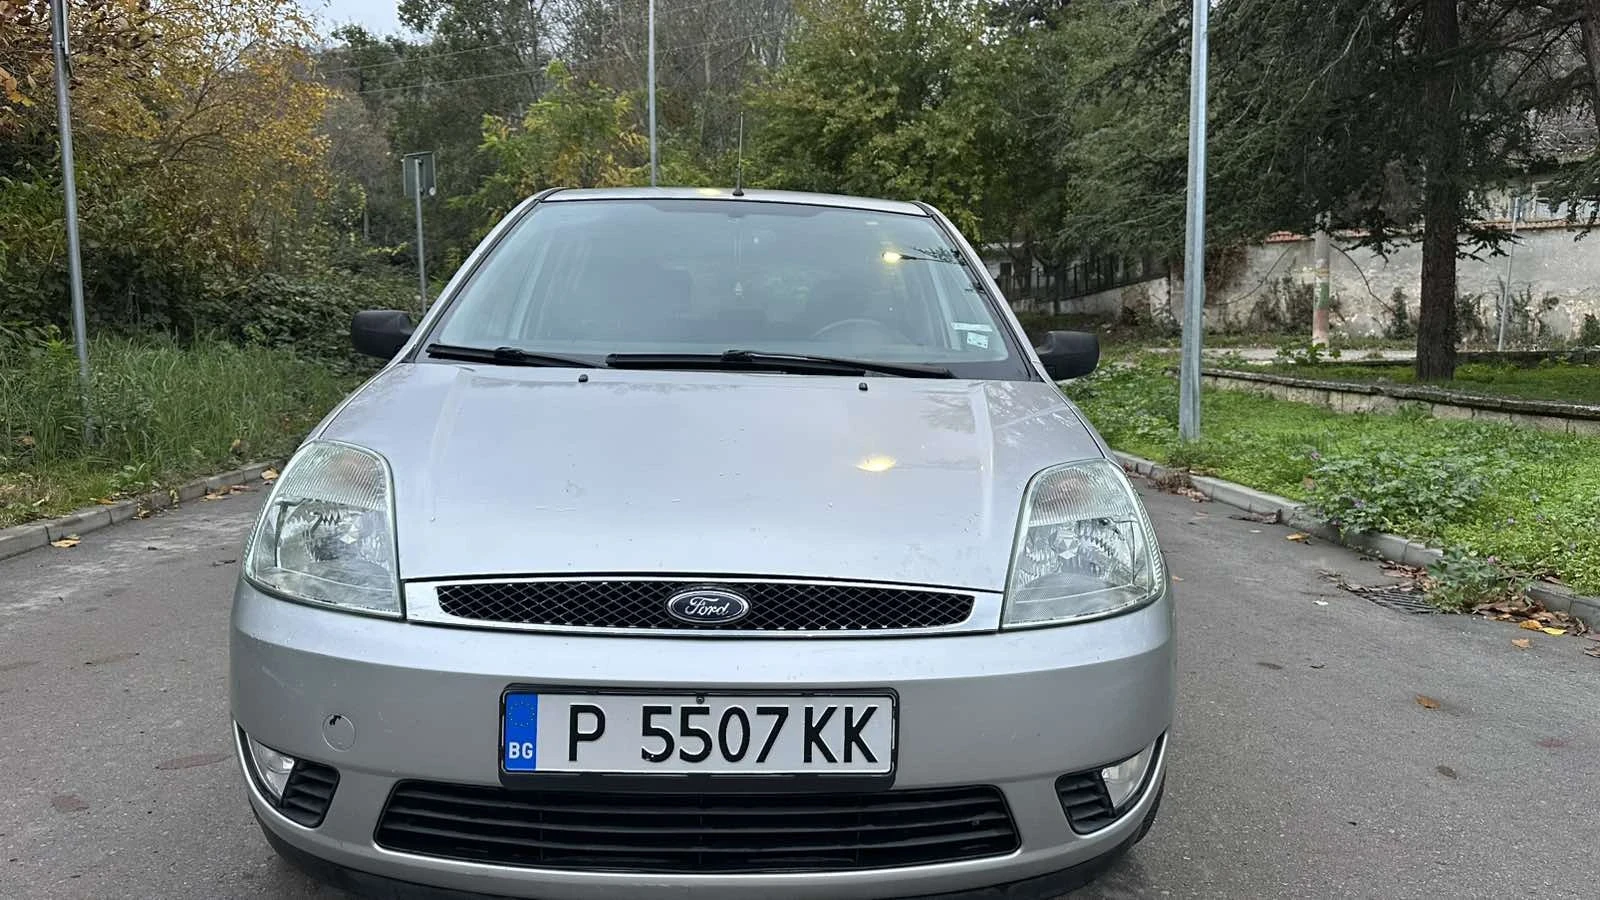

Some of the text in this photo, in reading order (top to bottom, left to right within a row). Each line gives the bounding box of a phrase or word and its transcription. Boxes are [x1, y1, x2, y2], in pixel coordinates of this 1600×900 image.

[685, 597, 730, 616] Ford
[568, 704, 879, 764] P 5507 KK
[508, 742, 534, 760] BG
